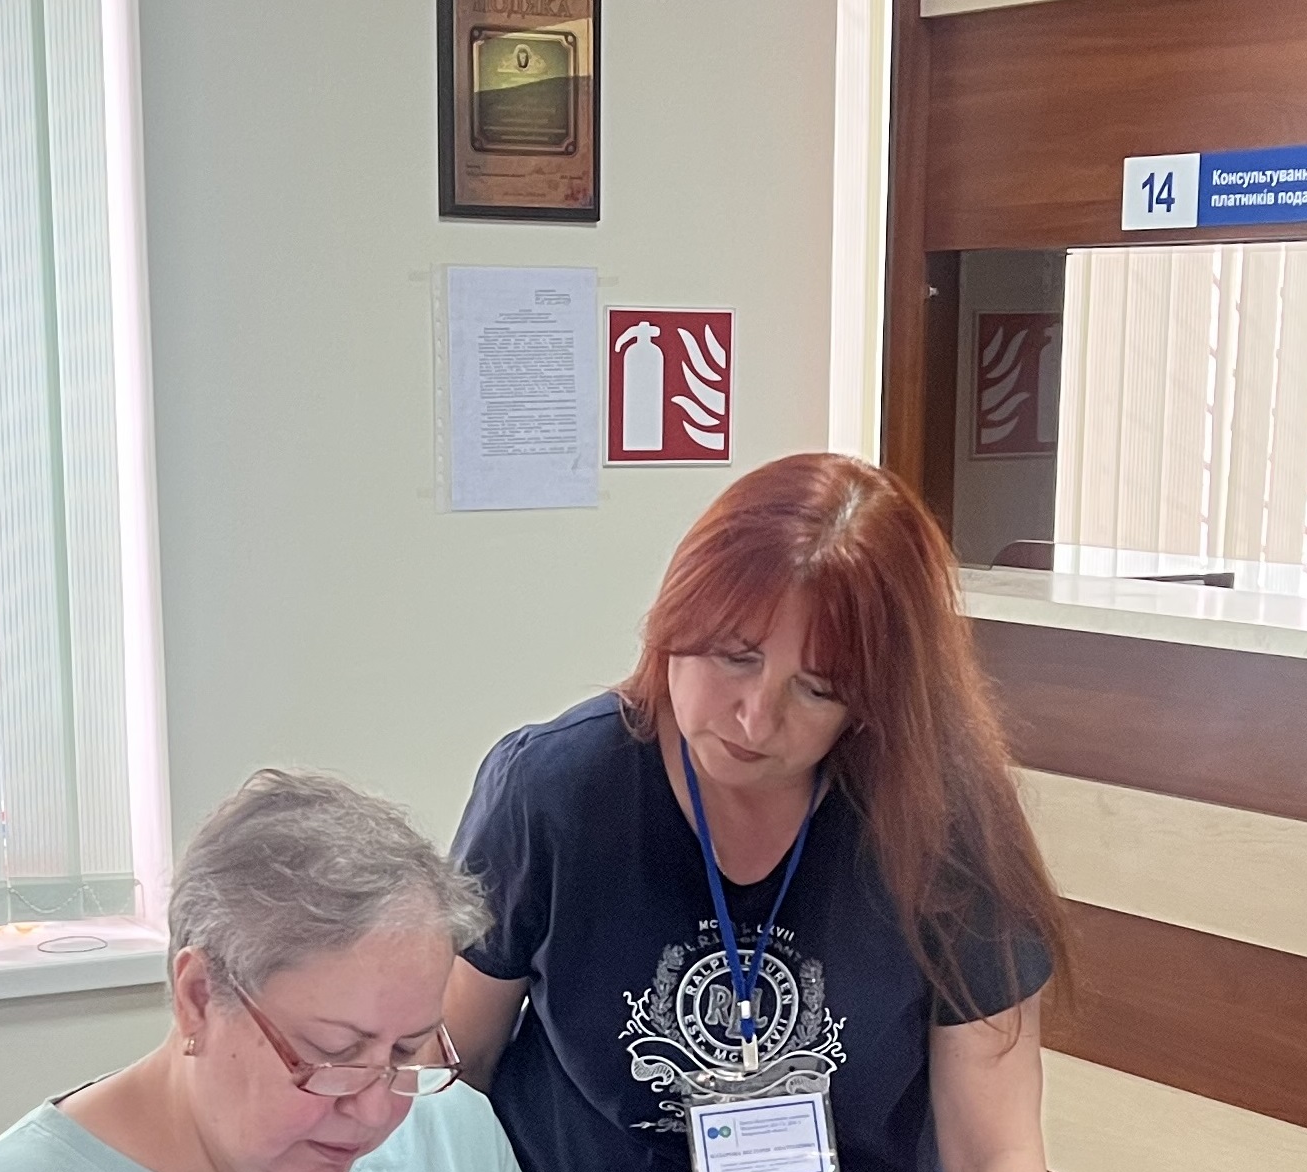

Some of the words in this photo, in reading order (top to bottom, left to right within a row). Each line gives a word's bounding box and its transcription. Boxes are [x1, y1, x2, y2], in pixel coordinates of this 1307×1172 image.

[1141, 171, 1175, 213] 14
[1211, 189, 1274, 207] платників
[743, 955, 793, 1005] LUREN
